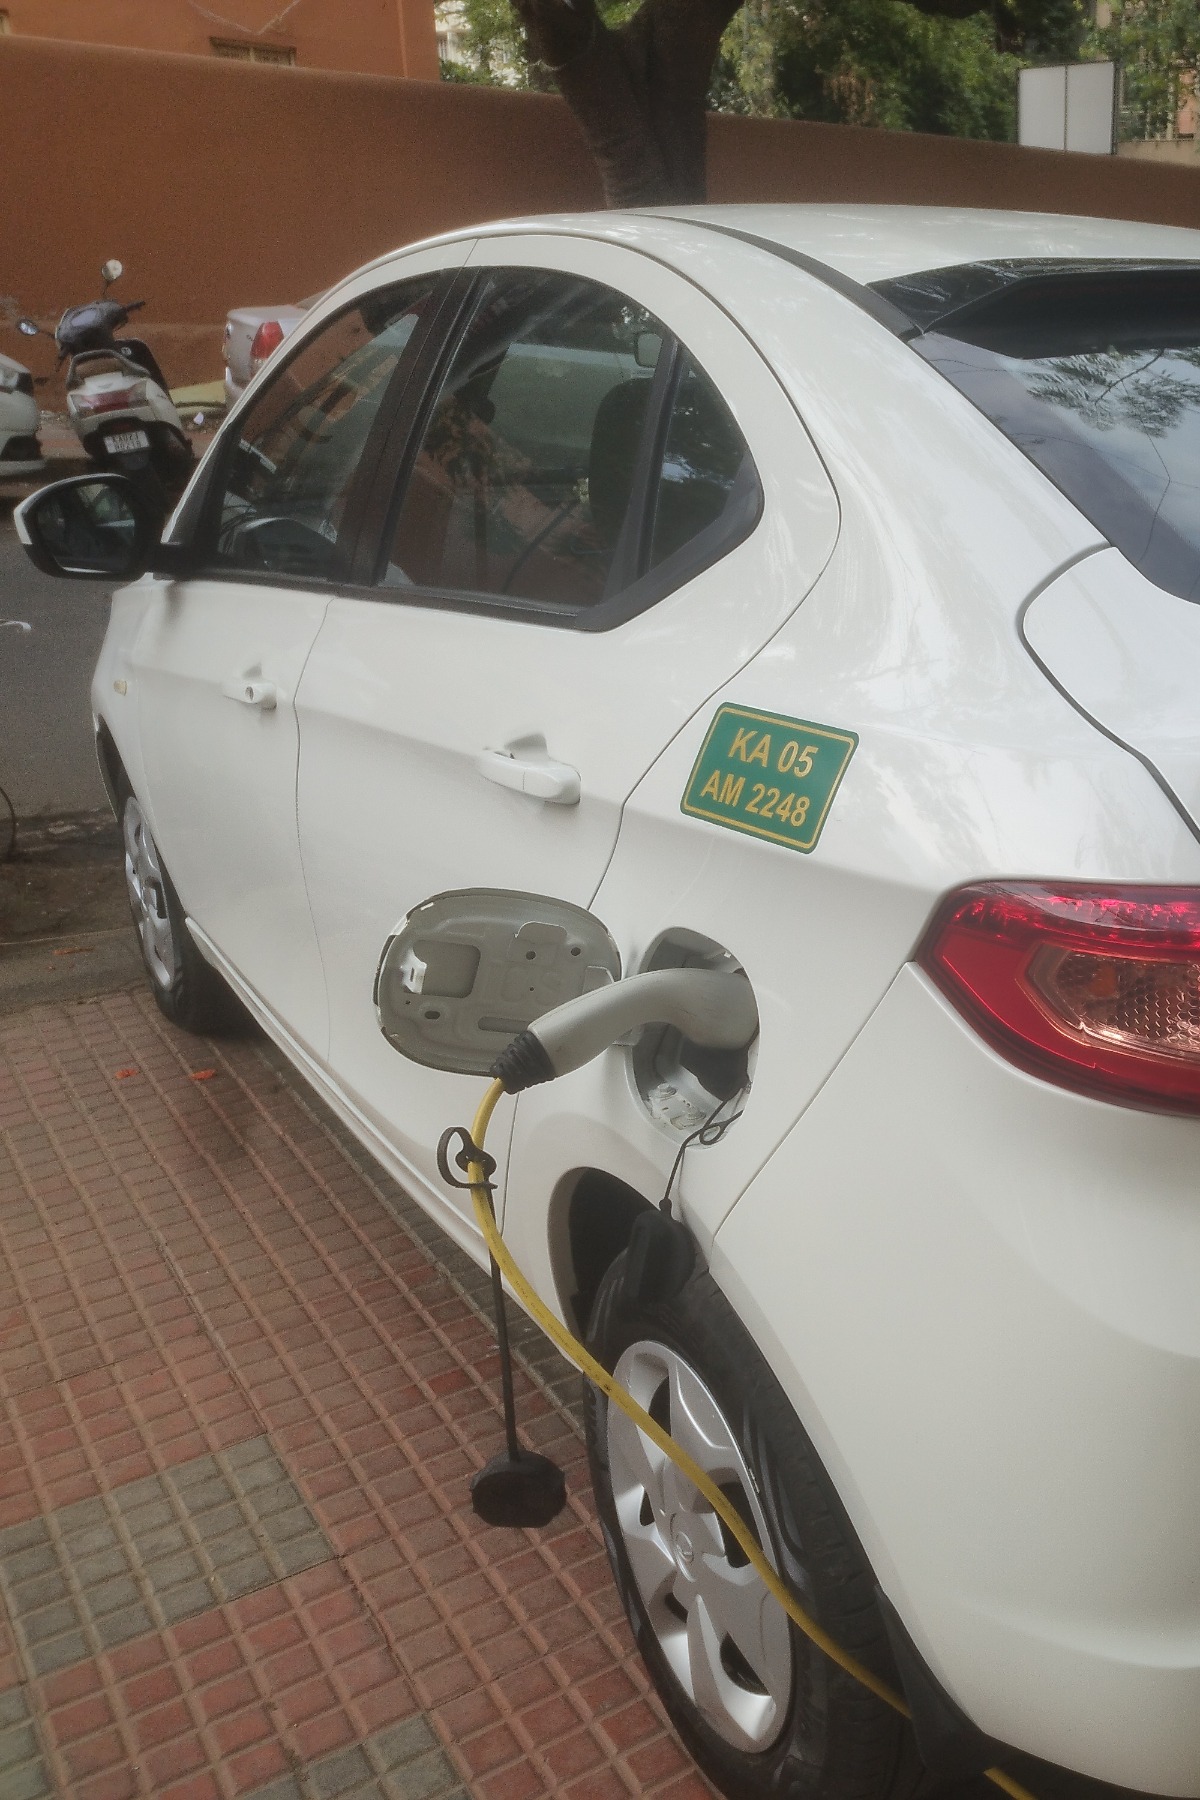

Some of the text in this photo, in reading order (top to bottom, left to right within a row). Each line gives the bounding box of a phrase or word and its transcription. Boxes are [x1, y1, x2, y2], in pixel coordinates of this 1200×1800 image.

[728, 727, 819, 778] KA 05
[700, 769, 811, 827] AM 2248
